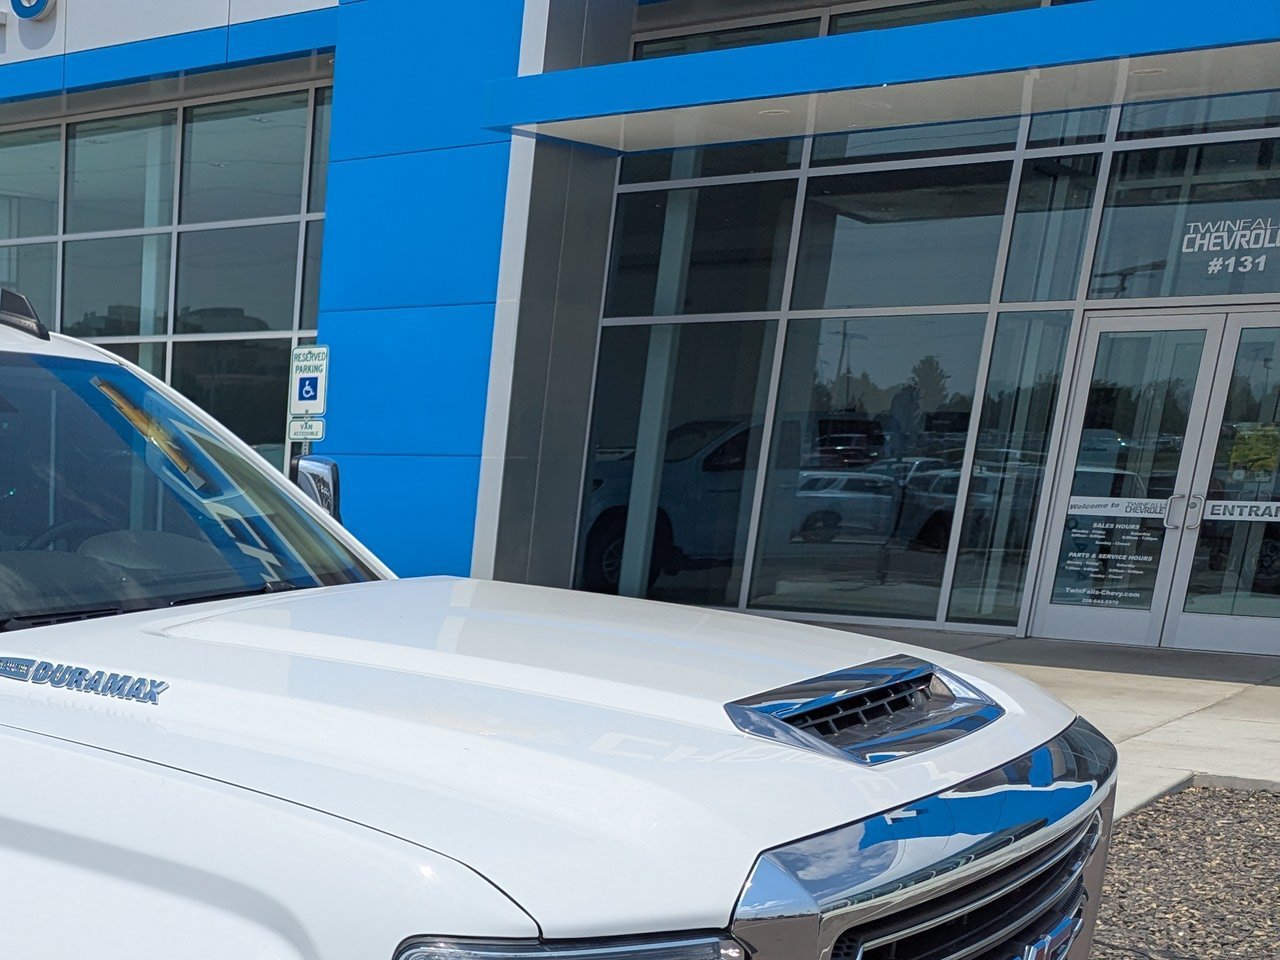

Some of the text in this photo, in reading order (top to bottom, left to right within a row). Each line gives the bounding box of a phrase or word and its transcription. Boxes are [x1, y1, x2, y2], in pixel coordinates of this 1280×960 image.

[1186, 218, 1280, 234] TWINFAL
[1207, 254, 1267, 274] #131
[293, 352, 326, 362] RESERVED
[295, 365, 324, 374] PARKING
[300, 422, 313, 430] VAN
[1124, 506, 1167, 514] CHEVROLE
[1065, 587, 1140, 598] TwinFalls-Chevy.com
[31, 661, 170, 705] DURAMAX
